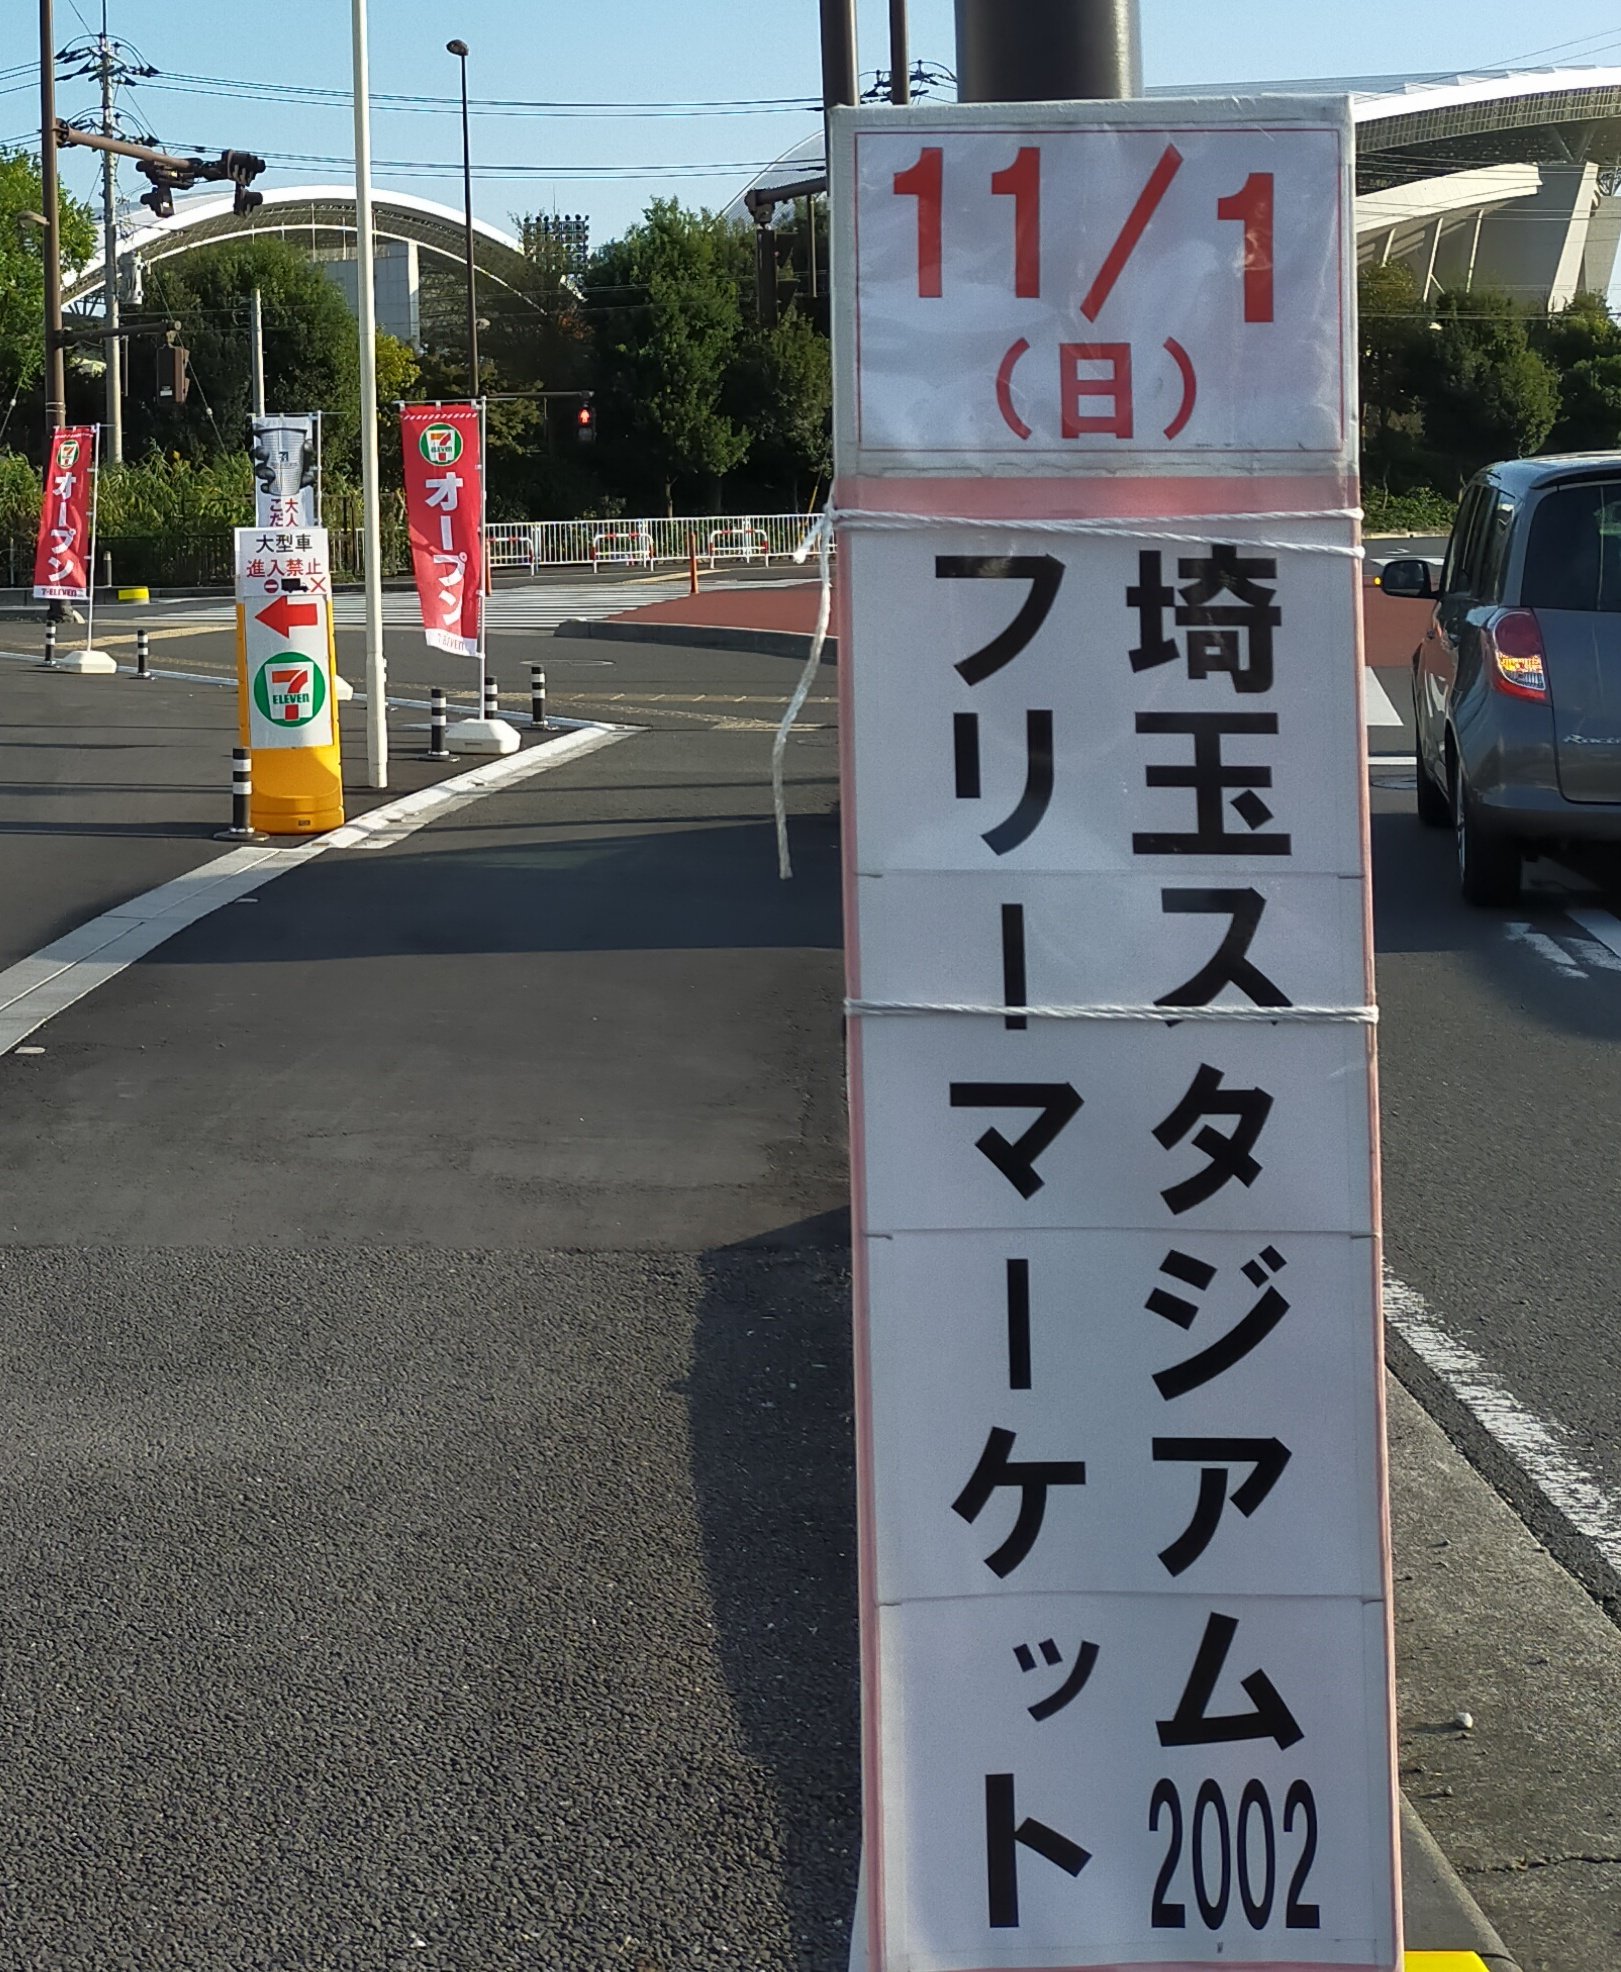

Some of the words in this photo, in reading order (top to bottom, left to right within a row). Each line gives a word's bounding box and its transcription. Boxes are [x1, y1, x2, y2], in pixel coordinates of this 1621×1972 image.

[894, 143, 1274, 323] 11/1
[48, 471, 77, 582] オープン
[246, 557, 323, 578] 進入禁止
[255, 533, 313, 553] 大型車
[425, 471, 468, 626] オープン
[935, 553, 1101, 1929] フリーマーケット
